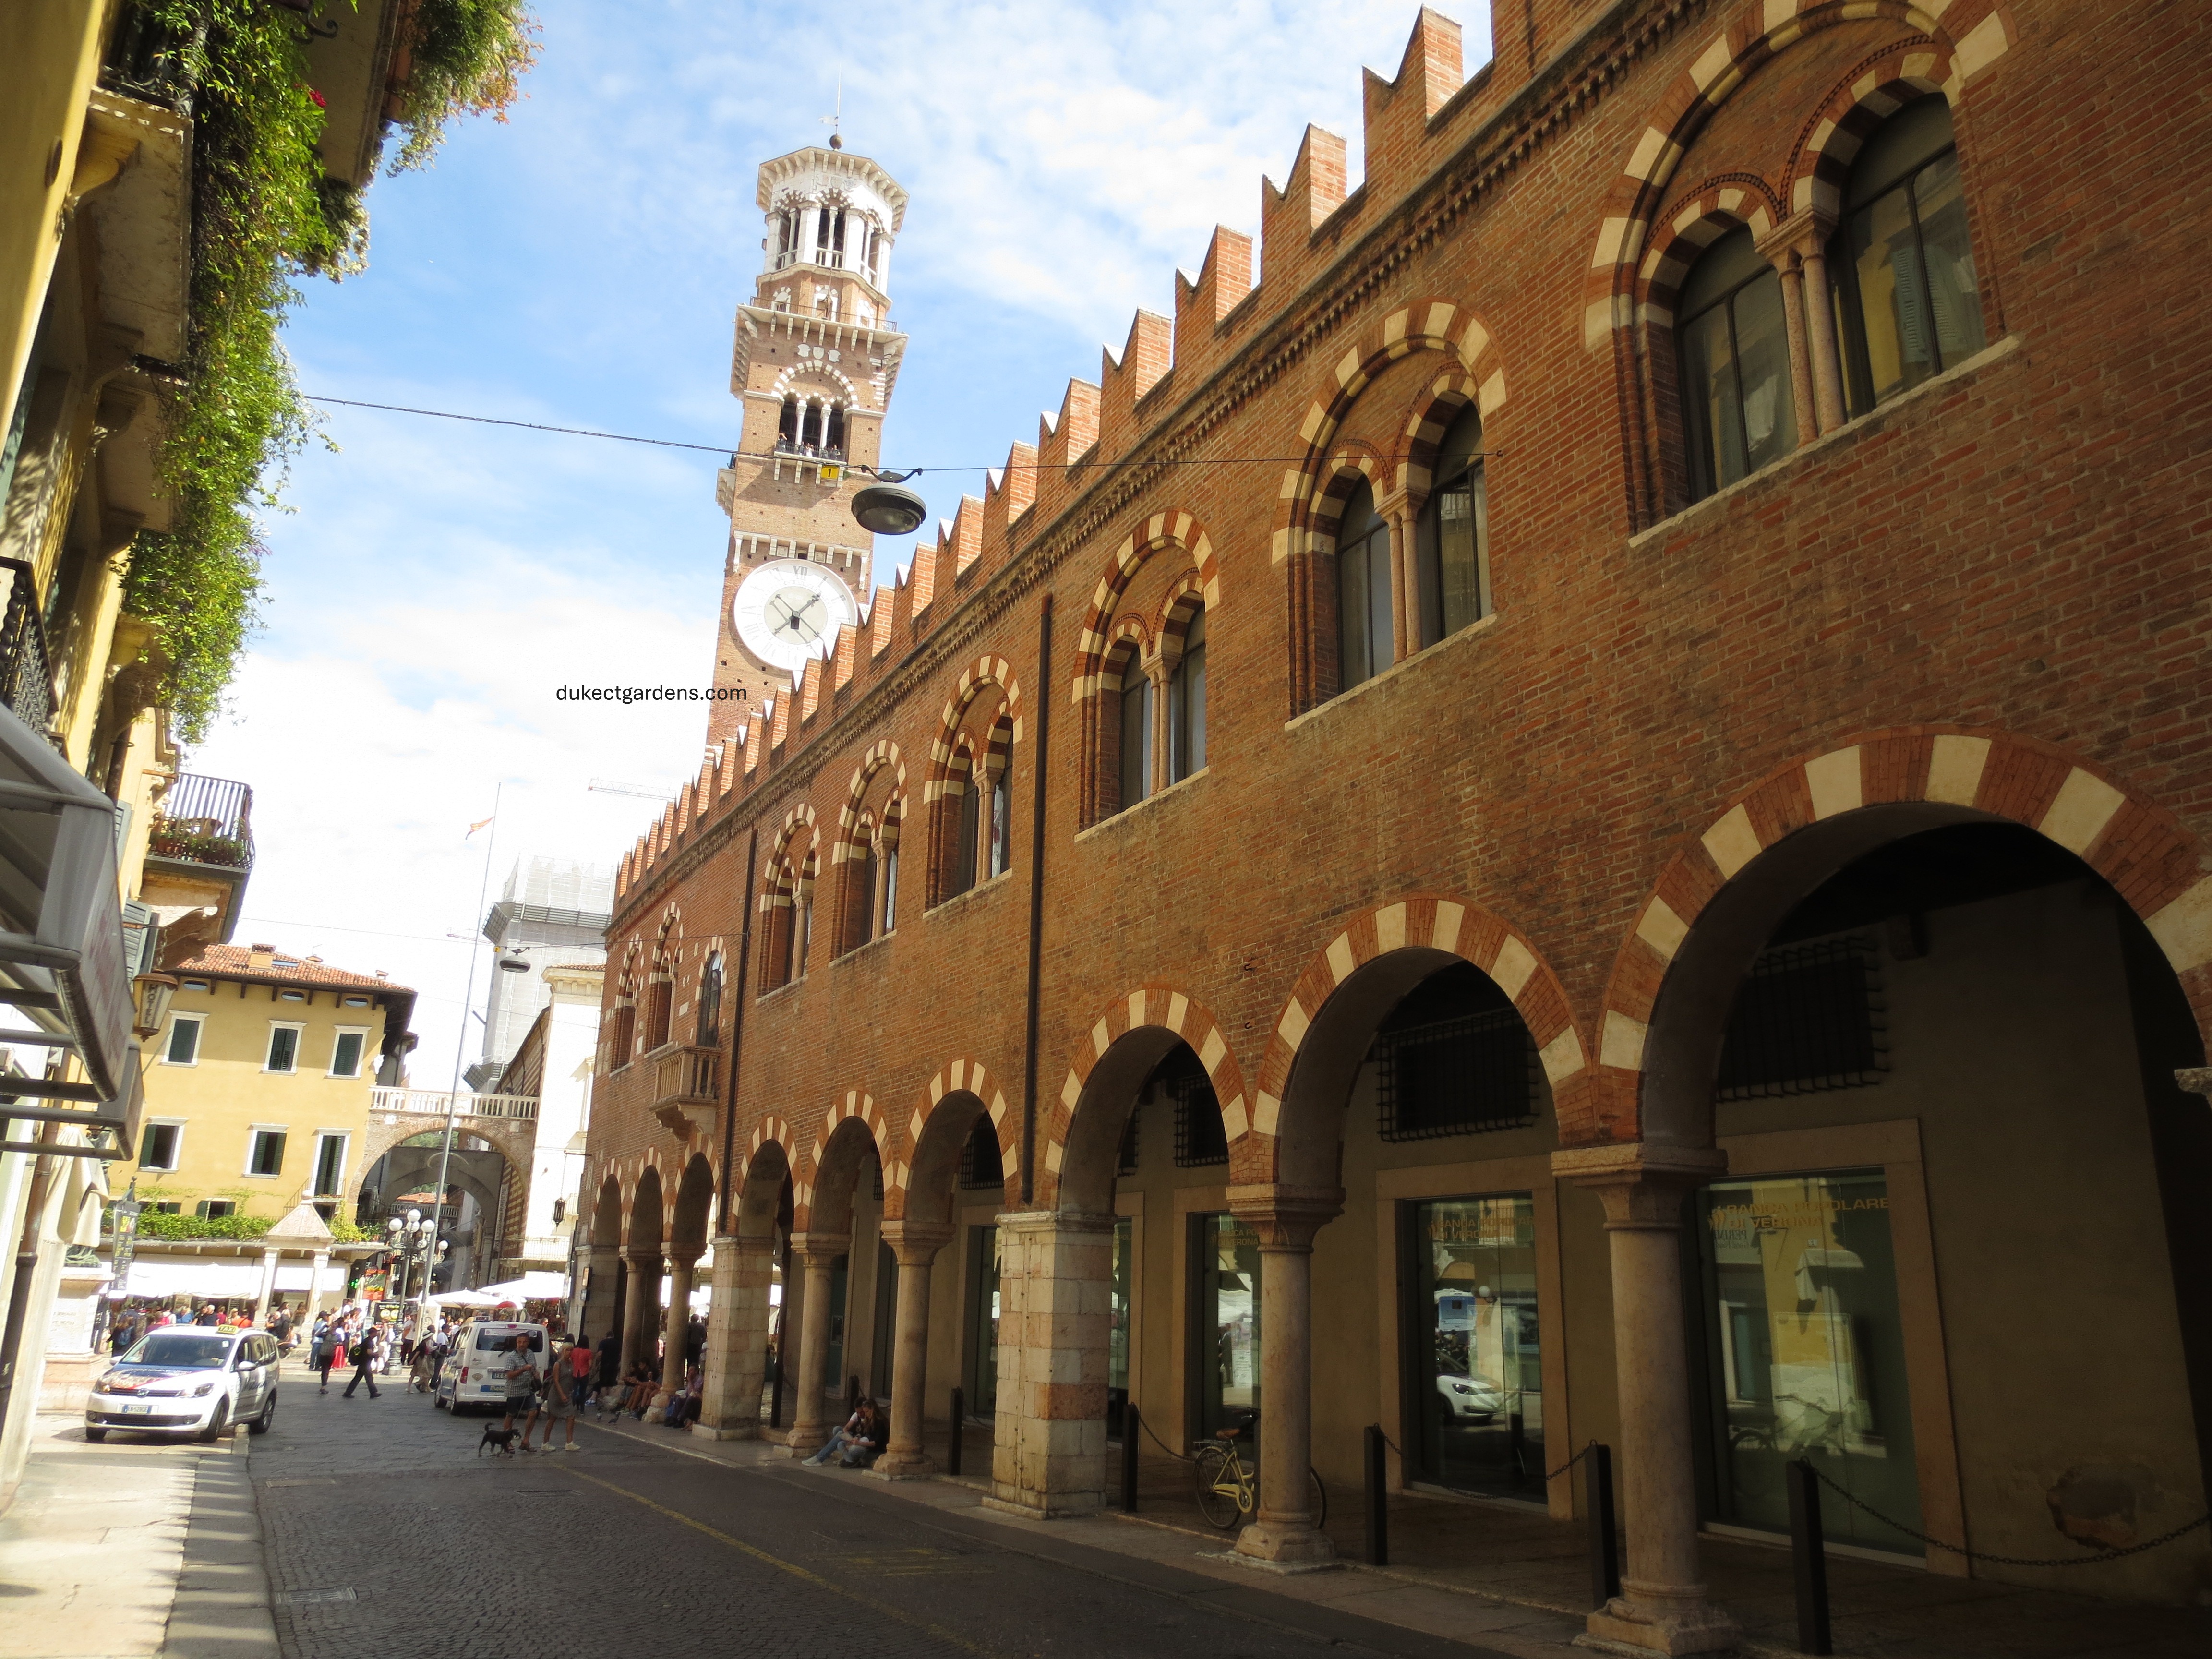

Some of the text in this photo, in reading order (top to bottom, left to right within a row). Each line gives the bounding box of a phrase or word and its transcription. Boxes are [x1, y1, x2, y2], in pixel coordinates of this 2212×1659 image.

[828, 468, 832, 478] 1
[144, 984, 158, 1024] HOTEL
[1726, 1202, 1789, 1214] BANCA
